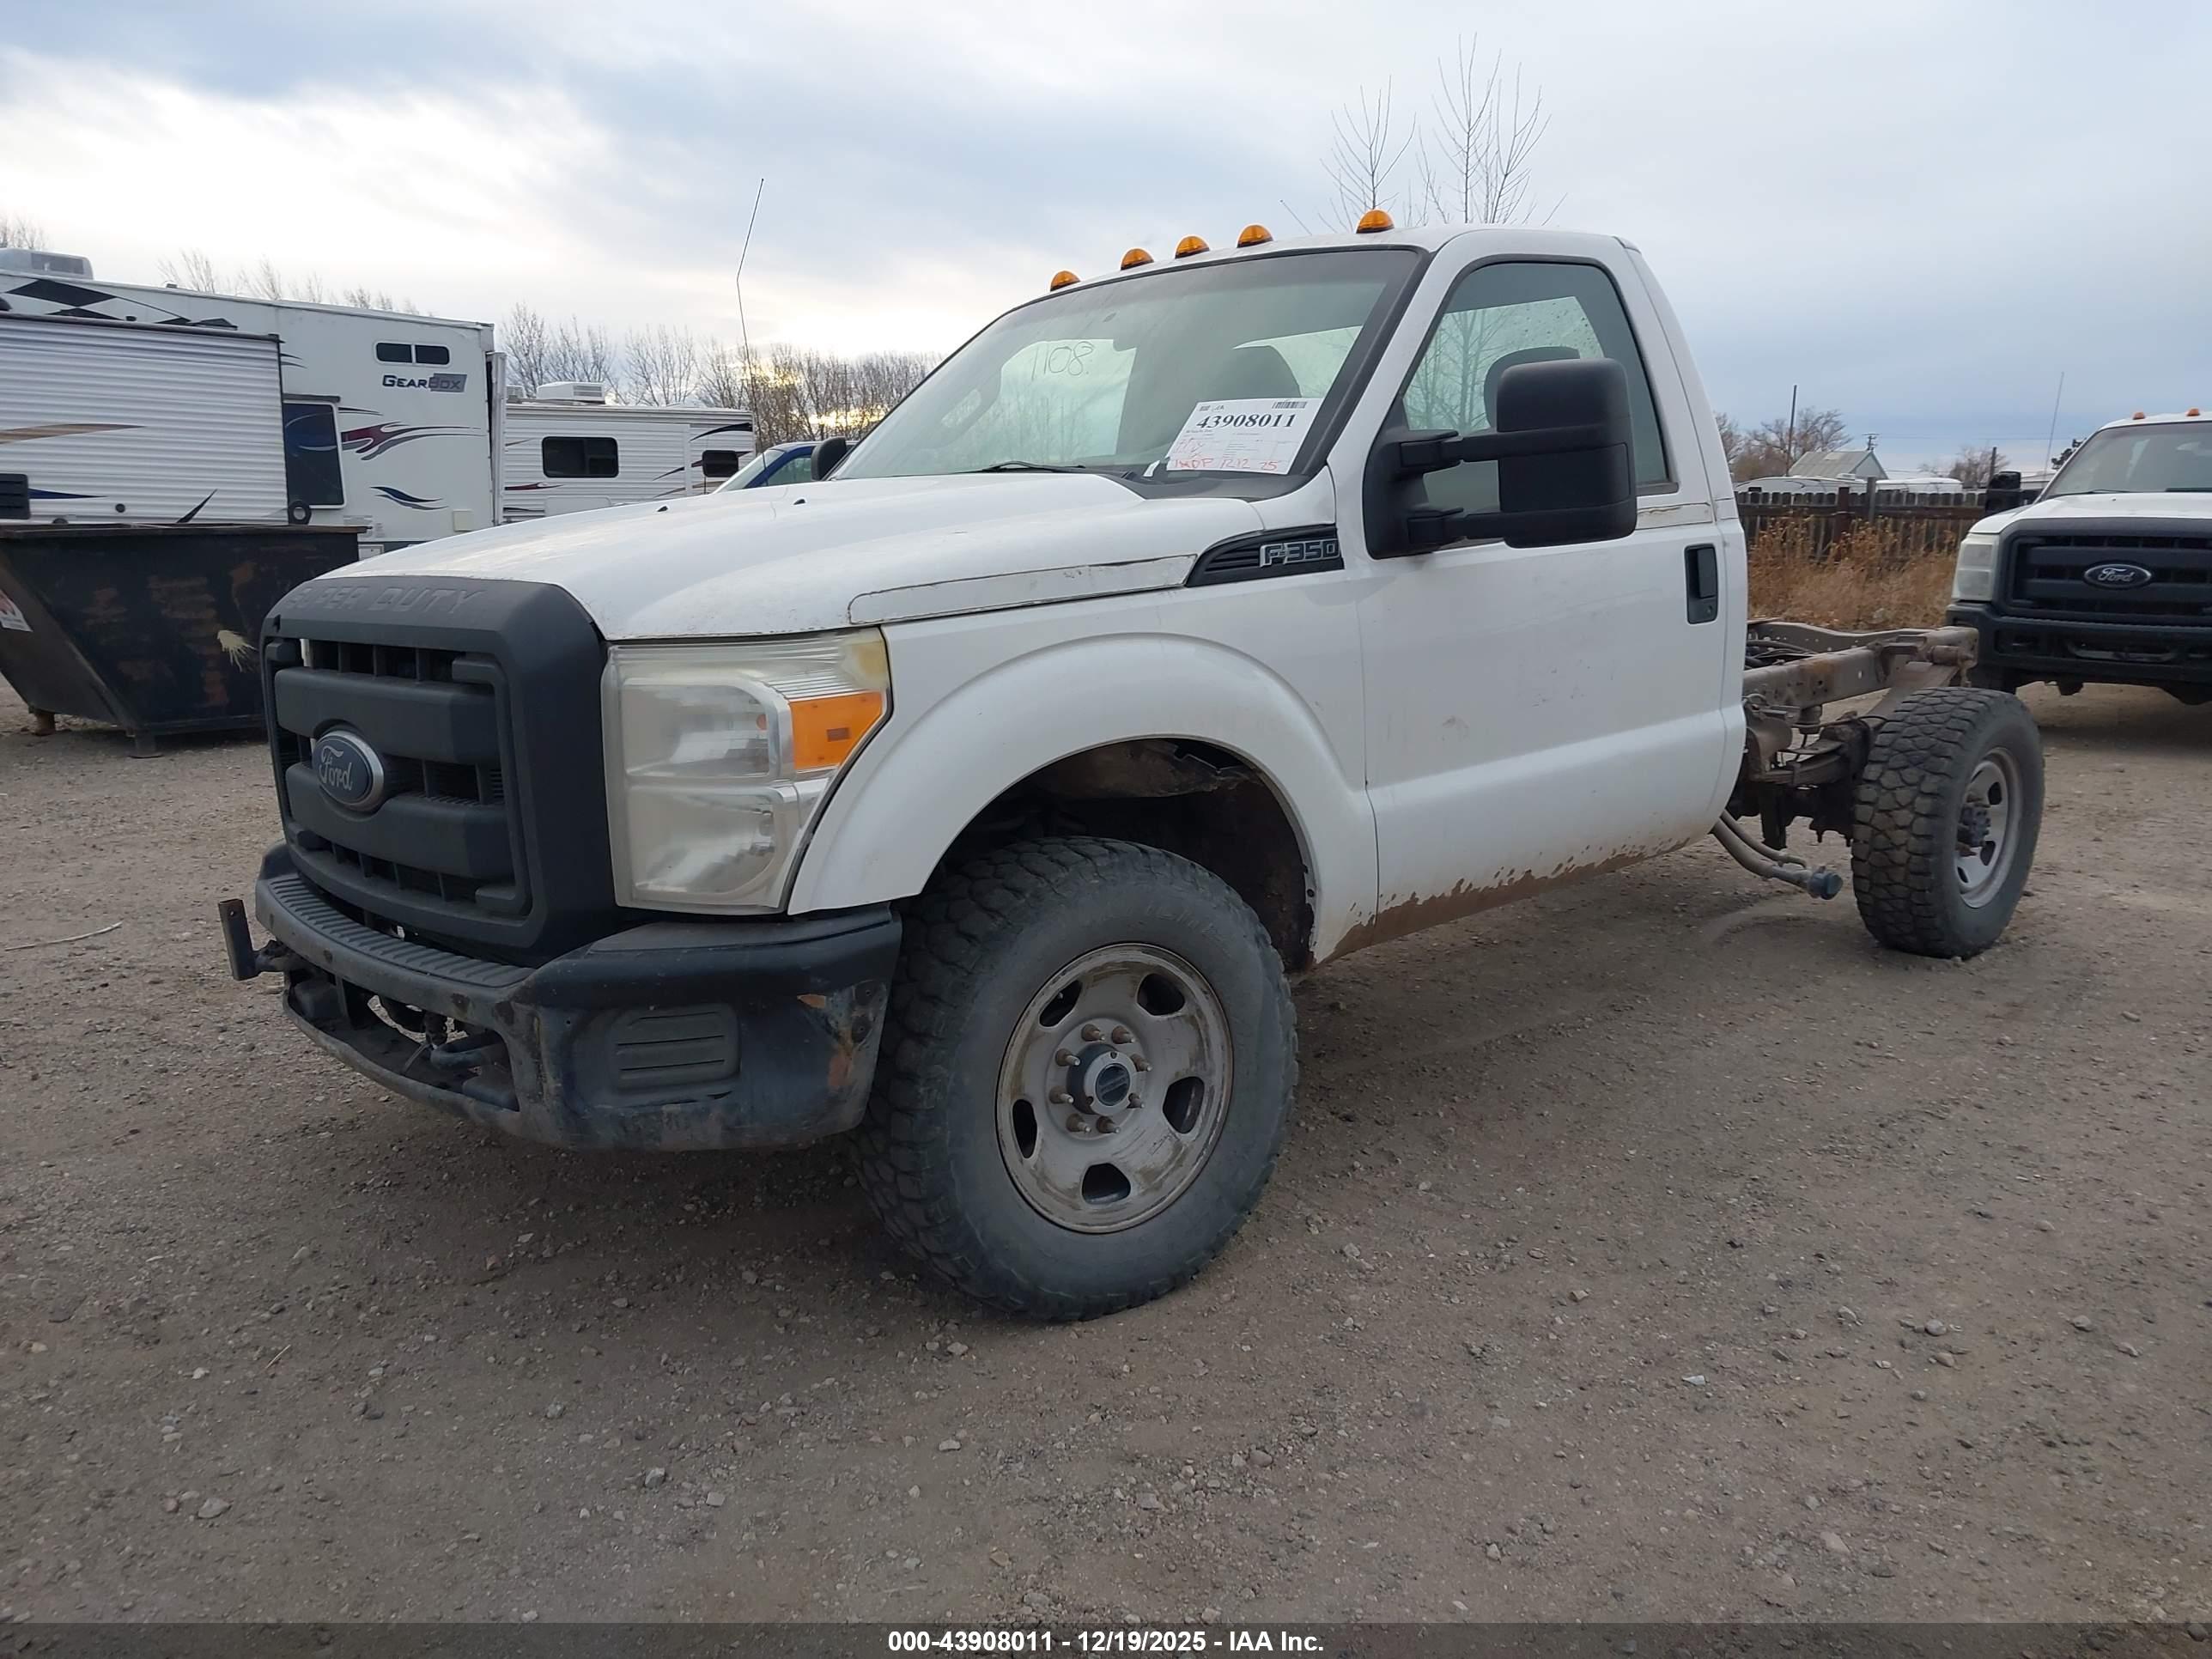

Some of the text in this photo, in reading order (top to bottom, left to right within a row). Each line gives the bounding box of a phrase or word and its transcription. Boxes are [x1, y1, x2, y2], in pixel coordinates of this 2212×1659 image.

[1196, 413, 1296, 428] 43908011
[2098, 567, 2136, 582] Ford
[285, 586, 488, 615] SUPER DUTY
[319, 745, 353, 791] Ford
